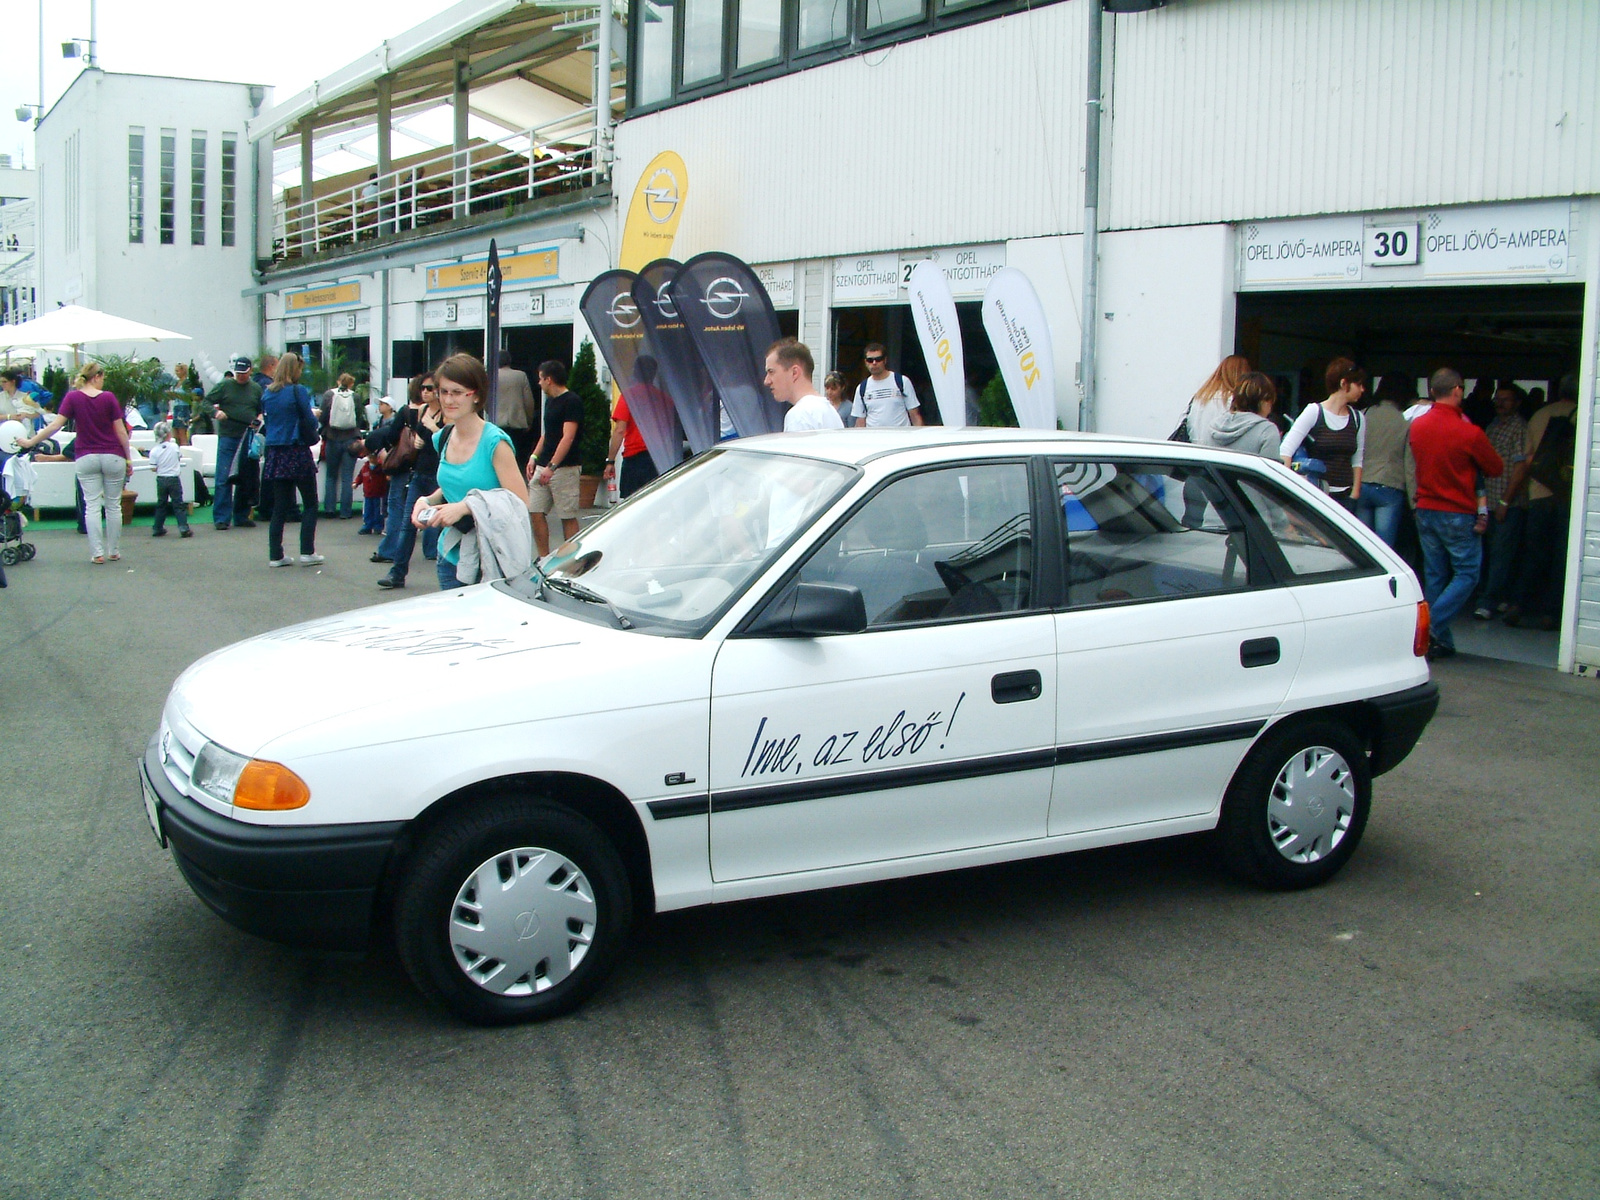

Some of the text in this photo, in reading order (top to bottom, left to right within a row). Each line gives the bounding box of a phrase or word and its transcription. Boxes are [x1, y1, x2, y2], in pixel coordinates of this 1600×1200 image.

[1373, 230, 1409, 258] 30
[1427, 228, 1568, 253] OPEL JÖVŐ=AMPERA
[1247, 238, 1362, 261] OPEL JÖVŐ=AMPERA
[856, 259, 875, 272] OPEL
[956, 251, 977, 265] OPEL
[760, 269, 774, 280] OPEL
[836, 271, 898, 288] SZENTGOTTHÁRD
[902, 263, 917, 283] 2
[761, 279, 792, 292] OTTHÁRD
[447, 306, 454, 318] 26
[531, 298, 540, 311] 27
[813, 730, 859, 767] az
[862, 691, 966, 764] első!
[664, 771, 696, 787] GL
